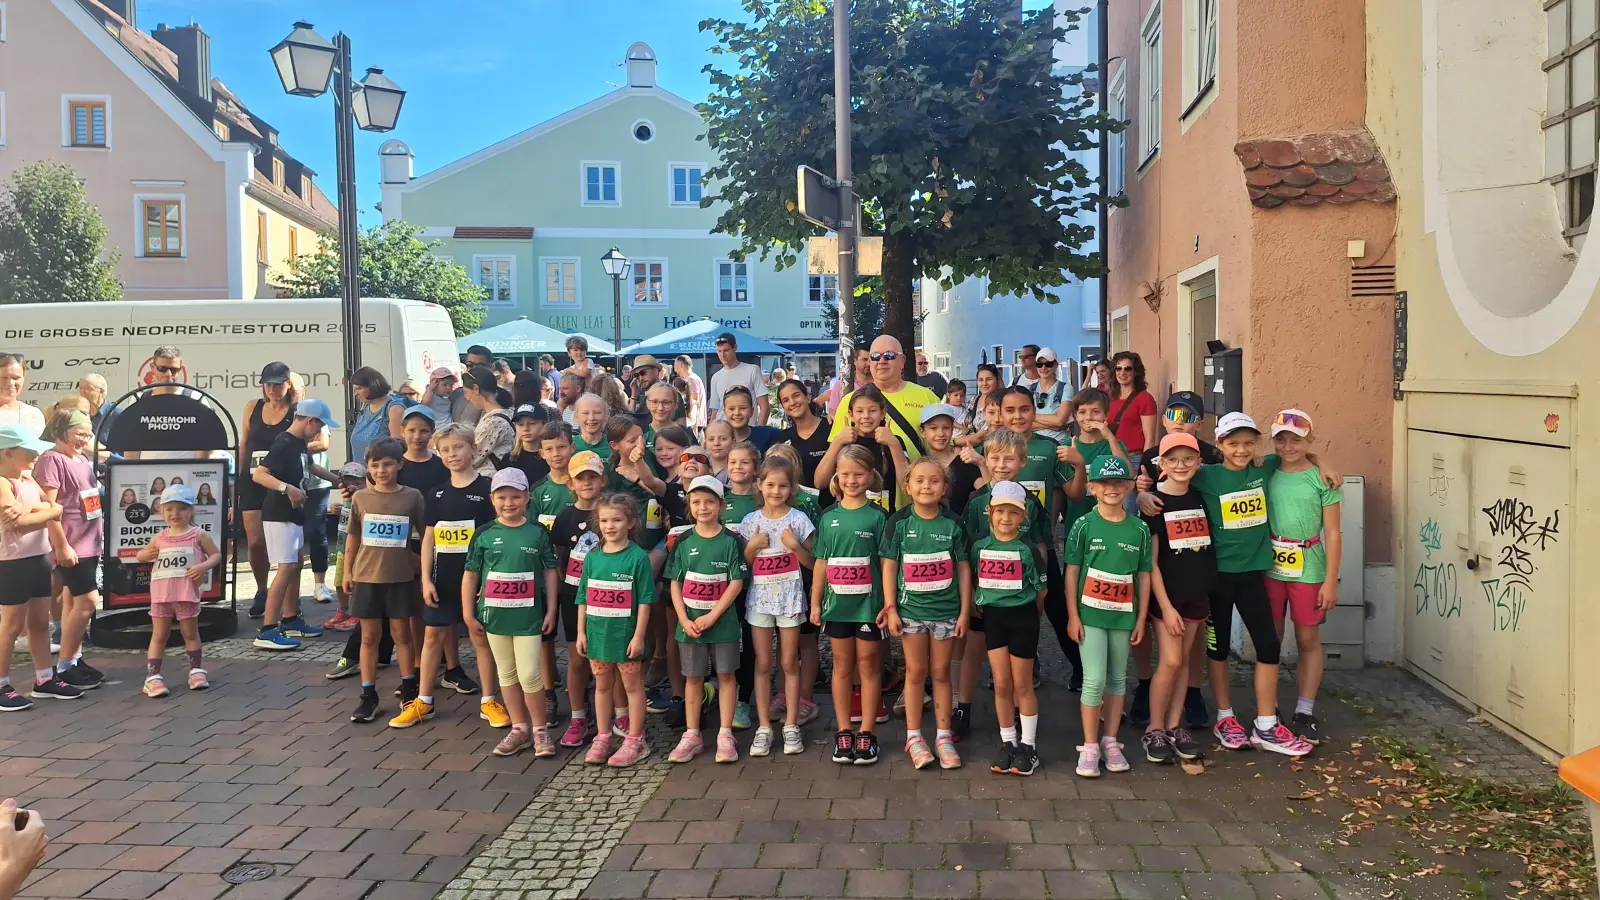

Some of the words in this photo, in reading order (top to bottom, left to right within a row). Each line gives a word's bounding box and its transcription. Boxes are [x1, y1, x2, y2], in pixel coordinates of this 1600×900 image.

[548, 315, 578, 329] GREEN
[583, 315, 604, 329] LEAF
[609, 315, 632, 329] CFE
[799, 320, 822, 329] OPTIK
[5, 329, 34, 339] DIE
[40, 327, 115, 338] GROSSE
[122, 323, 320, 336] NEOPREN-TESTTOUR
[140, 416, 197, 424] MAKEMOHR
[148, 423, 181, 431] PHOTO
[1230, 498, 1263, 515] 4052
[129, 511, 139, 519] 23
[369, 522, 402, 536] 2031
[1174, 519, 1205, 535] 3215
[439, 529, 469, 541] 4015
[157, 556, 188, 570] 7049
[758, 555, 791, 571] 2229
[911, 562, 947, 578] 2235
[980, 560, 1015, 575] 2234
[833, 566, 867, 580] 2232
[492, 581, 528, 595] 2230
[689, 582, 721, 597] 2231
[1091, 579, 1128, 598] 3214
[592, 589, 626, 604] 2236
